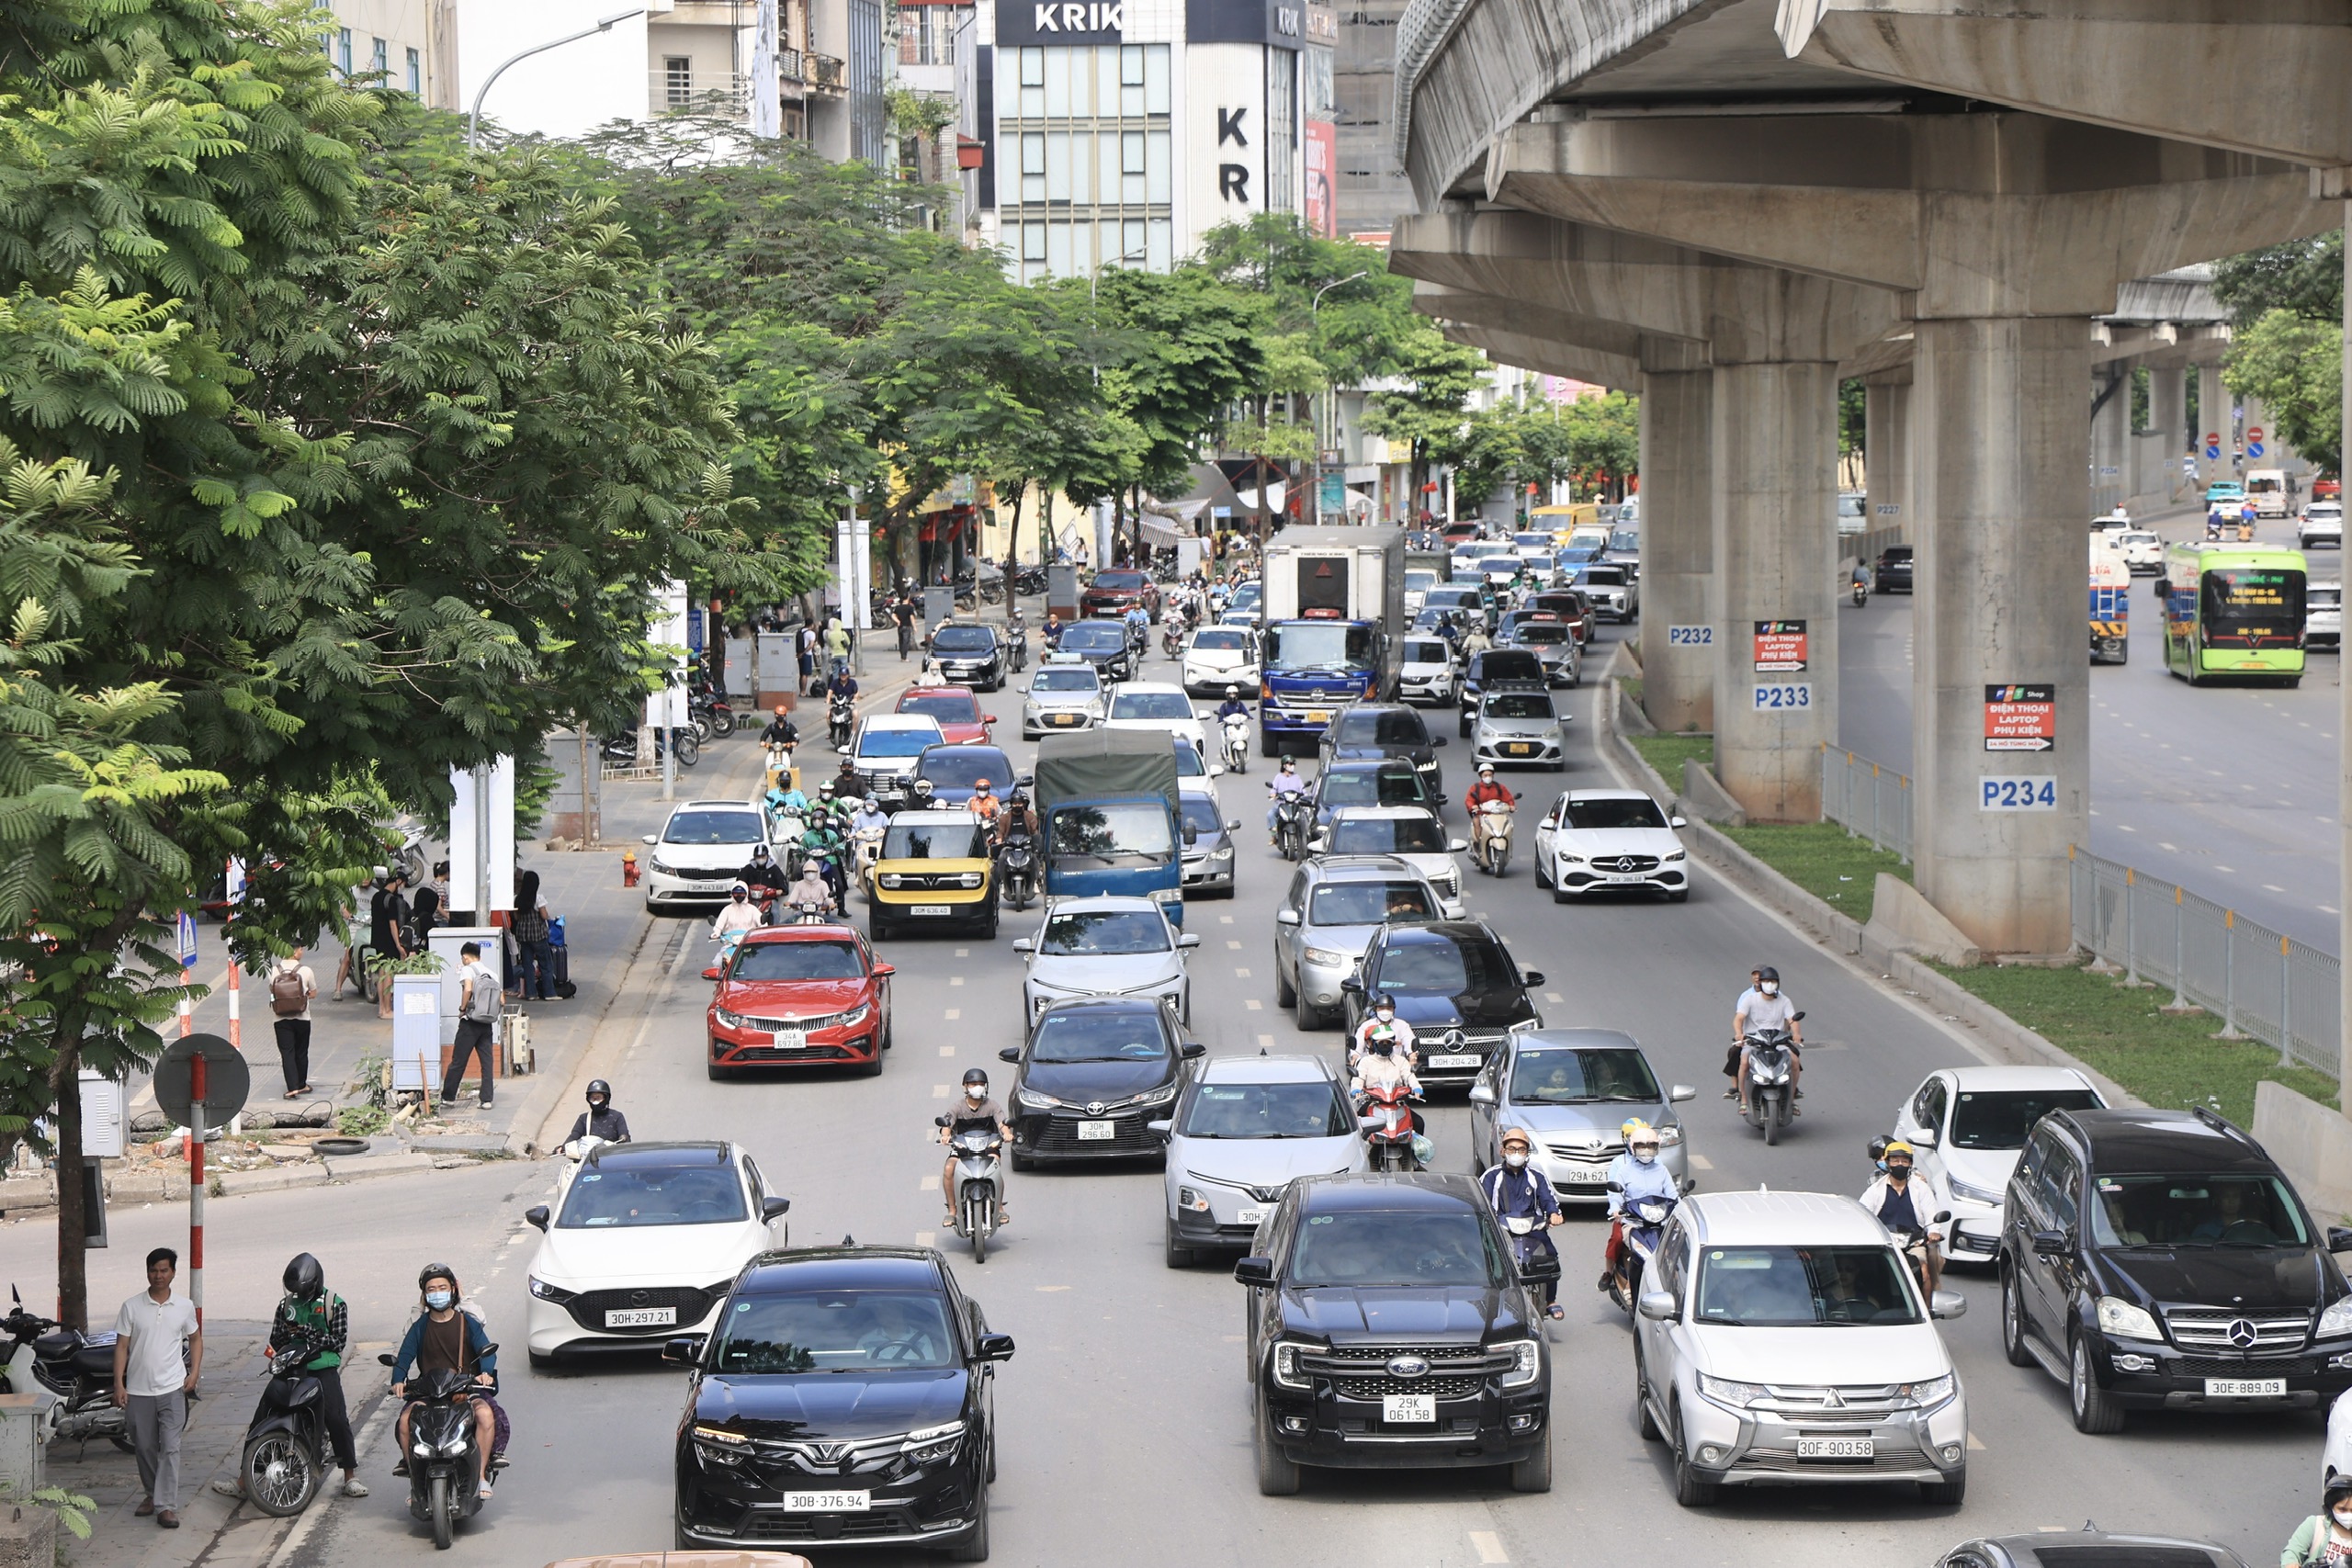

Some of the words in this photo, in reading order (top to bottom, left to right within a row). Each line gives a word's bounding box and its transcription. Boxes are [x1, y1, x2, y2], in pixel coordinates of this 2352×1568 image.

[1035, 3, 1123, 31] KRIK
[1278, 6, 1299, 36] KRIK
[1670, 627, 1712, 644] P232
[1756, 687, 1808, 707] P233
[1996, 685, 2024, 702] FPT
[1990, 703, 2015, 715] ĐIỆN
[2017, 705, 2049, 715] THOẠI
[1999, 716, 2040, 724] LAPTOP
[1994, 726, 2016, 736] PHỤ
[2018, 725, 2042, 736] KIỆN
[1984, 781, 2055, 807] P234
[611, 1312, 670, 1325] 30H-297.21
[1397, 1363, 1419, 1373] Ford
[2212, 1382, 2279, 1393] 30E-889.09
[1398, 1398, 1419, 1408] 29K
[1389, 1410, 1430, 1420] 061.58
[1800, 1441, 1871, 1455] 30F-903.58
[791, 1495, 863, 1507] 30B-376.94
